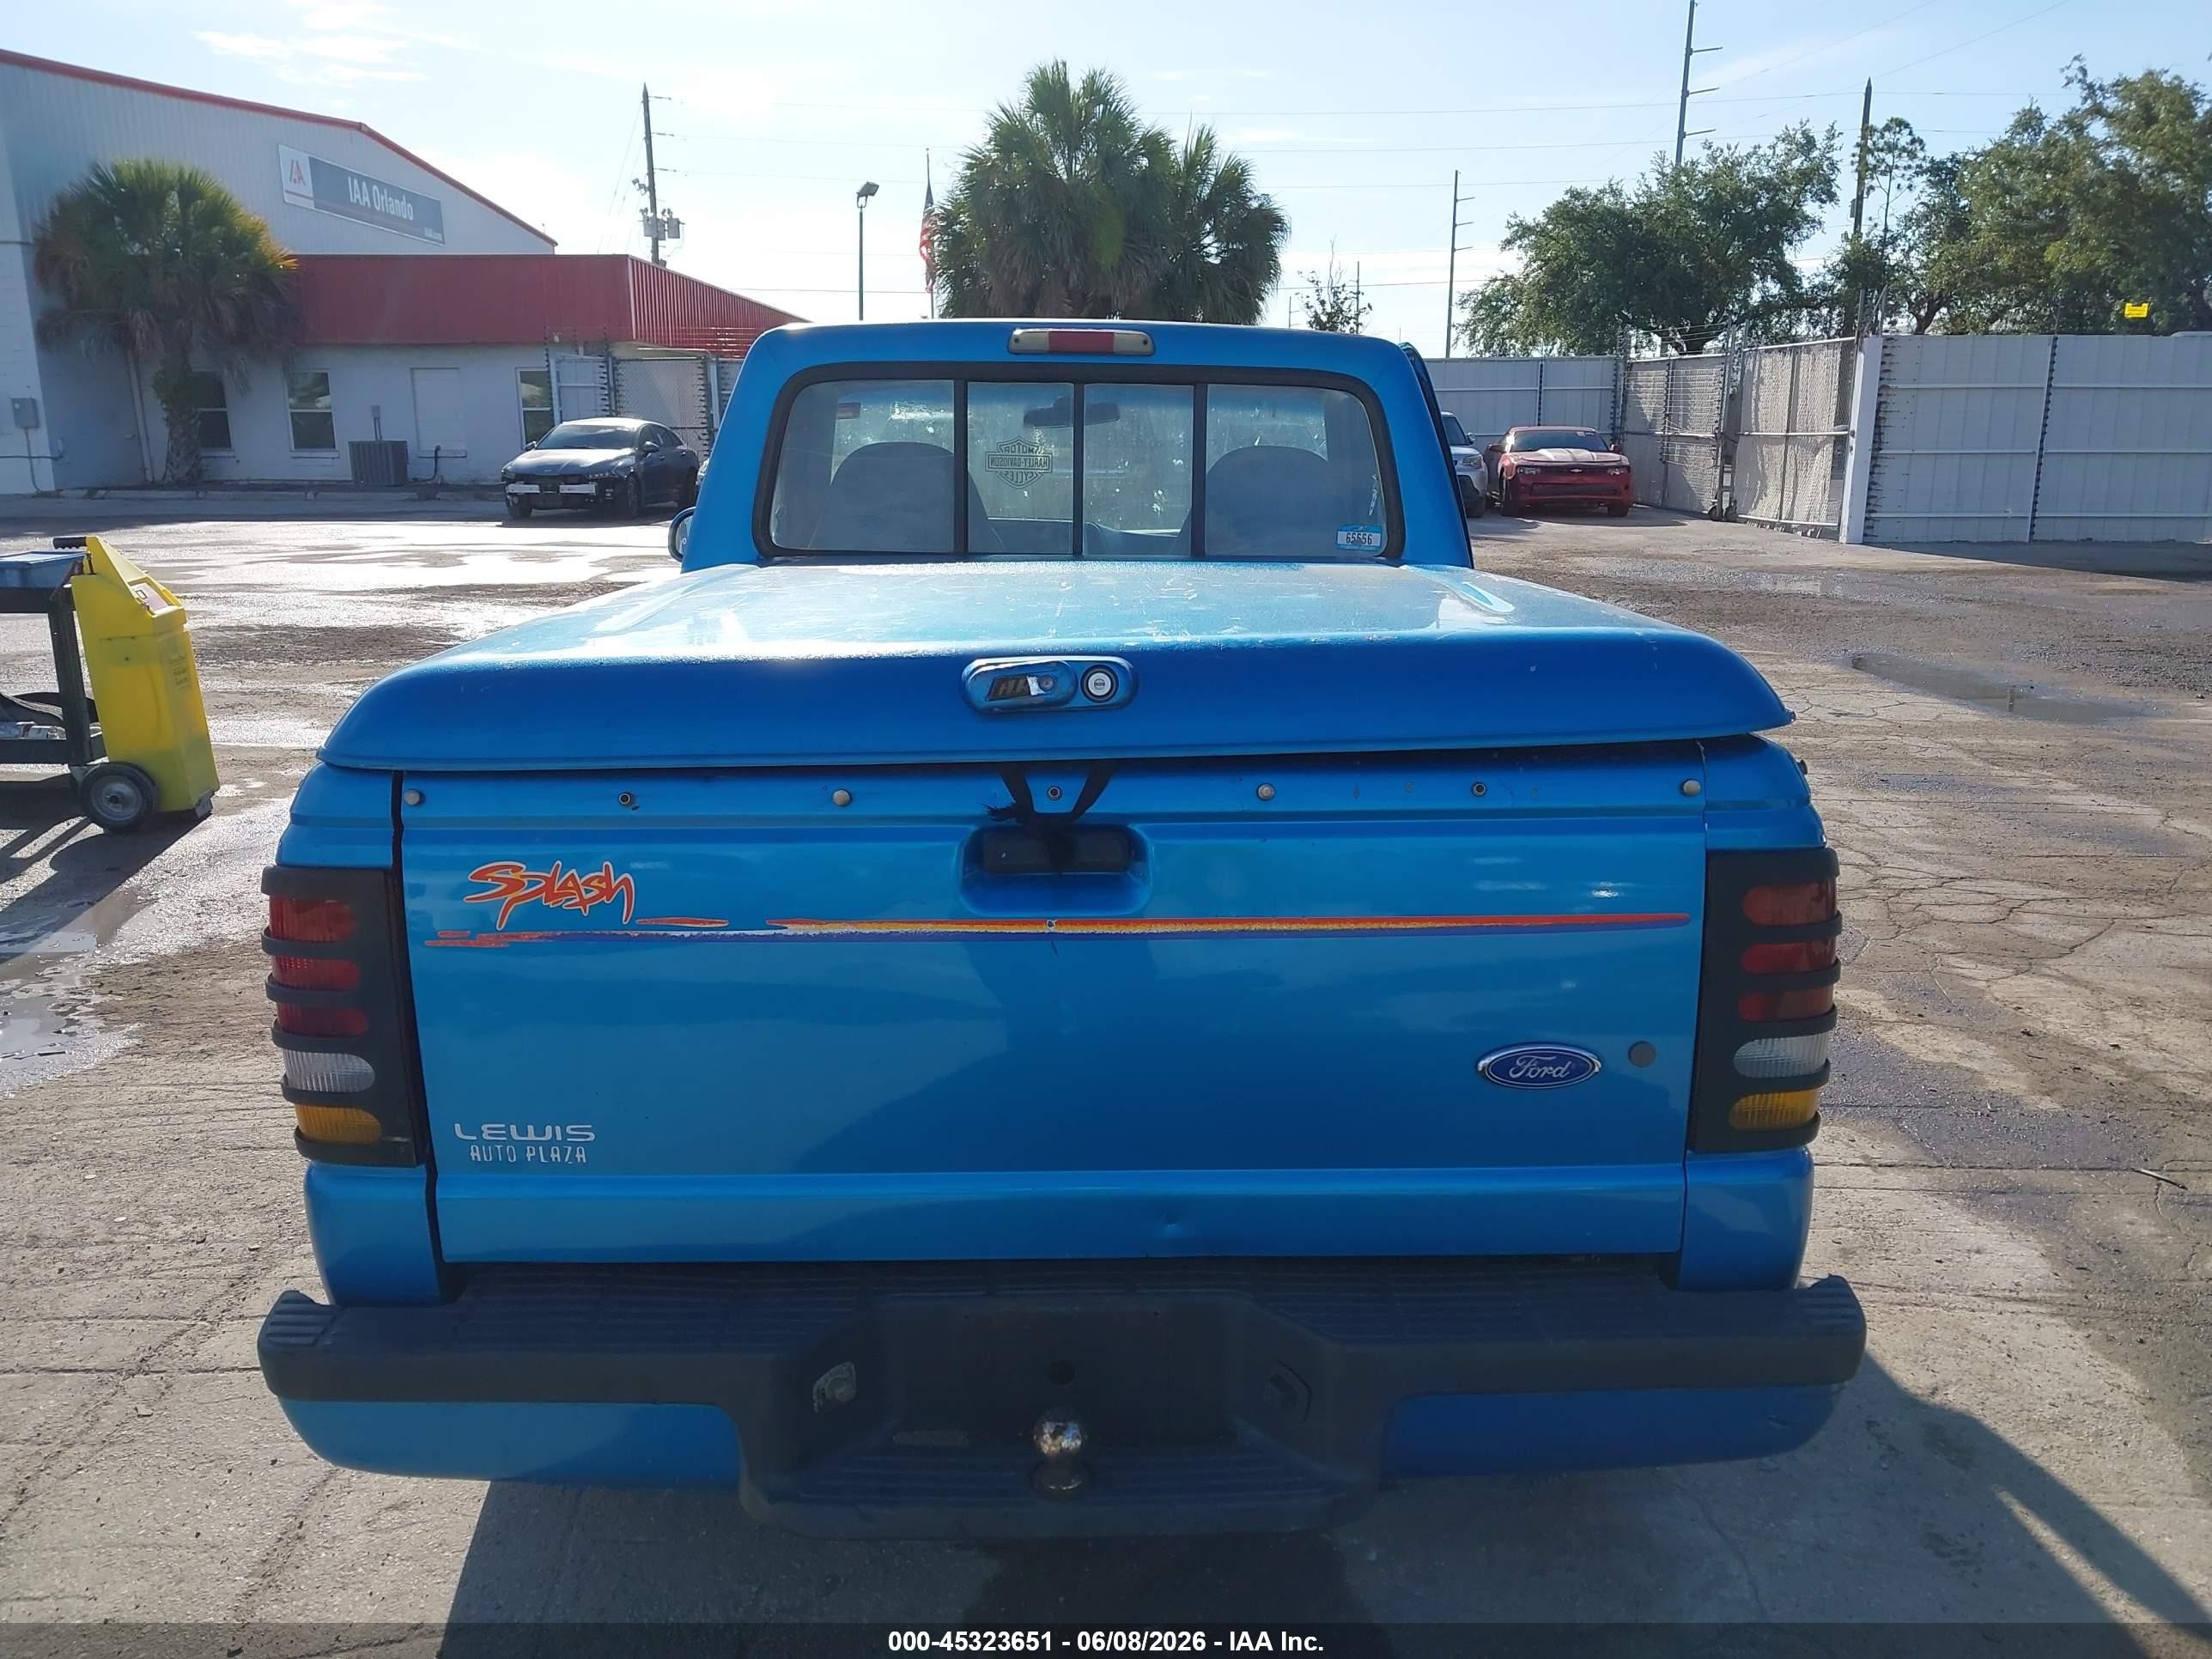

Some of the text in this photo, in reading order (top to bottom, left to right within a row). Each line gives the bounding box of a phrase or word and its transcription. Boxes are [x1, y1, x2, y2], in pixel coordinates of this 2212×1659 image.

[347, 176, 414, 222] IAA Orlando
[1509, 1055, 1571, 1079] Ford
[454, 1123, 596, 1141] LEWIS
[470, 1145, 587, 1164] AUTO PLAZA
